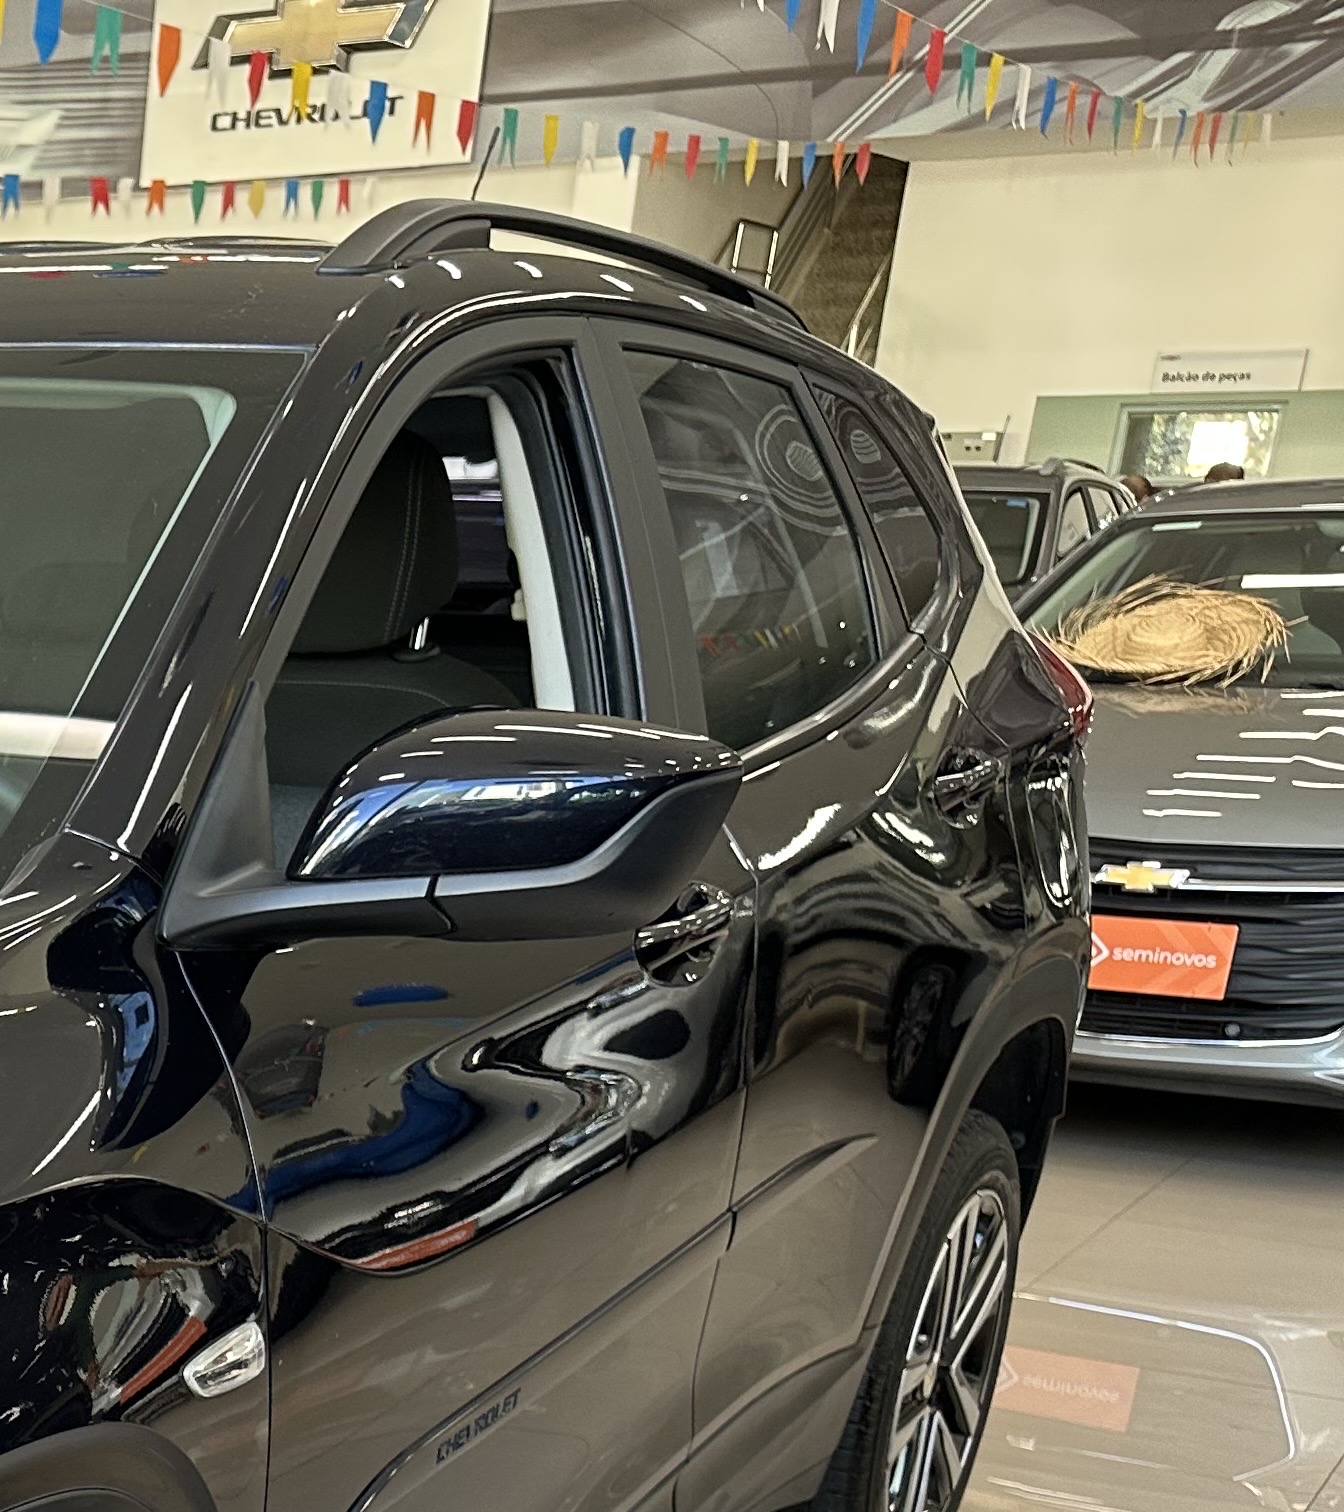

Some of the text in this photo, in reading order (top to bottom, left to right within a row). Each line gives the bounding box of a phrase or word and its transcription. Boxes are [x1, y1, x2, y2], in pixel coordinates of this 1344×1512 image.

[210, 96, 404, 132] CHEVRT
[1202, 371, 1216, 382] de
[1112, 947, 1217, 969] seminovos
[435, 1387, 522, 1465] CHEVROLET
